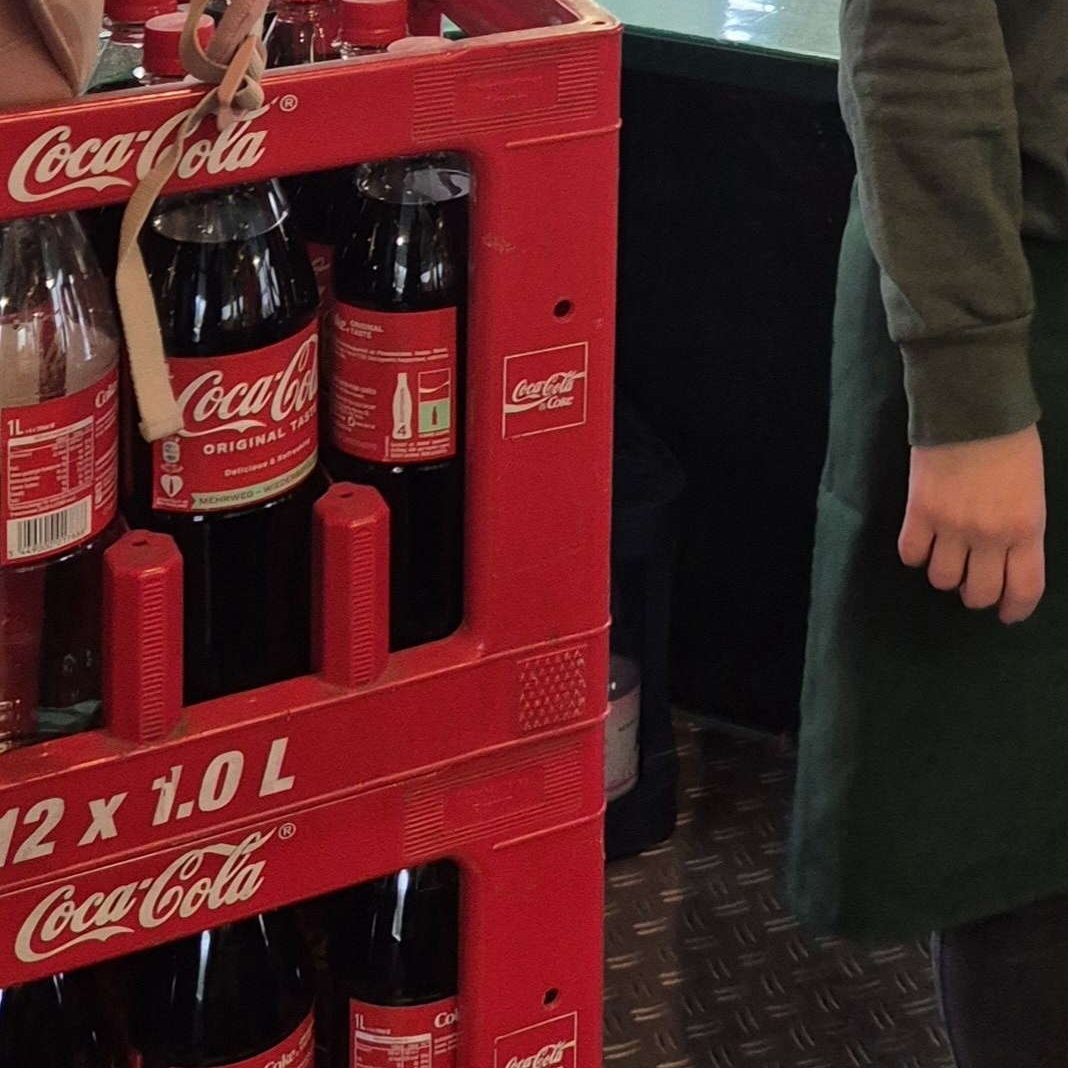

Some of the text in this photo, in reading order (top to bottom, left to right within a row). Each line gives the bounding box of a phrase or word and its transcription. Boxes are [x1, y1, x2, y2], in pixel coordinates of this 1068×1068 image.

[8, 97, 279, 202] Coca-Cola
[512, 370, 577, 402] Coca-Cola
[203, 428, 286, 455] ORIGINAL
[224, 460, 268, 477] Delicious
[199, 490, 254, 505] MEHRWEG
[0, 737, 296, 868] 12 x 1.0 L
[15, 827, 277, 963] Coca-Cola
